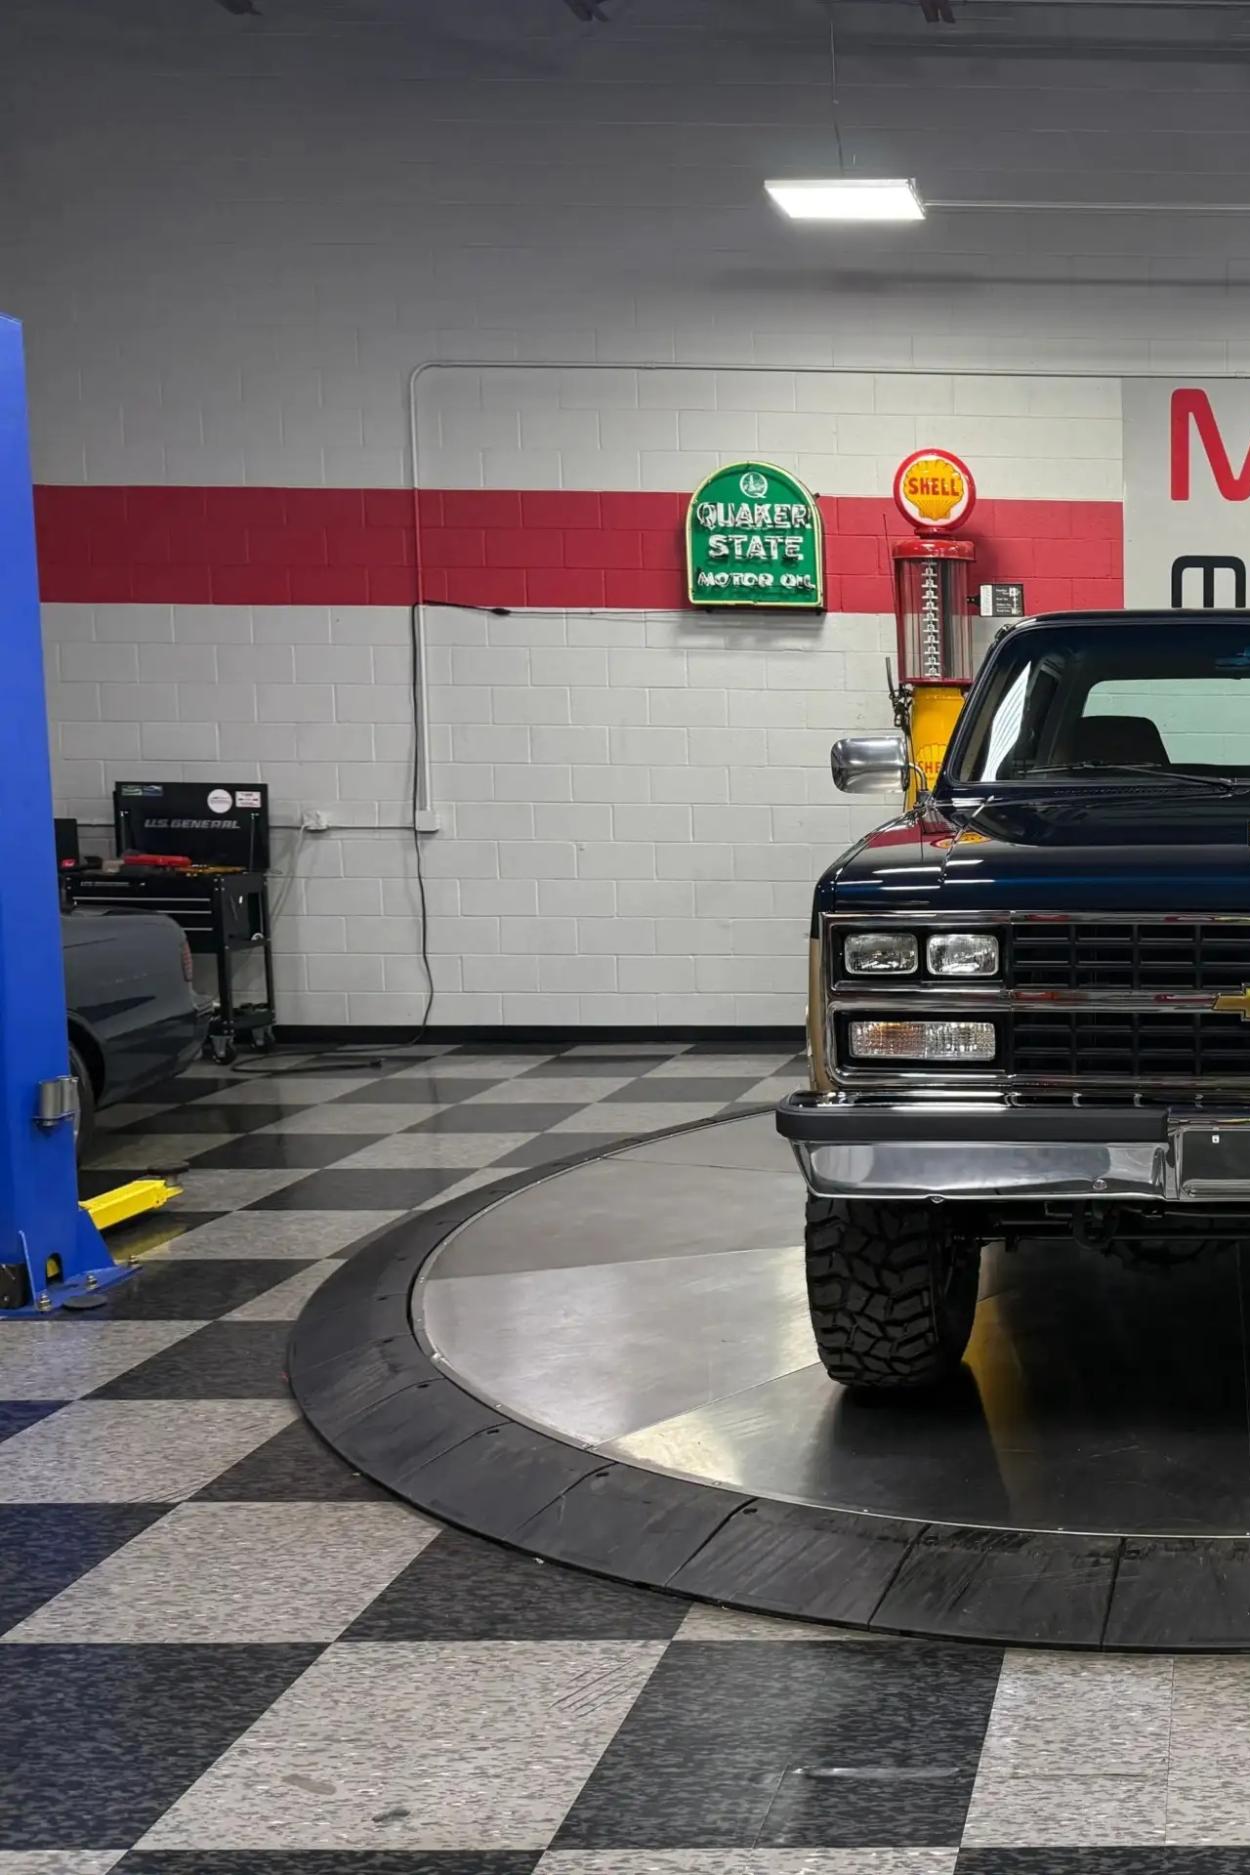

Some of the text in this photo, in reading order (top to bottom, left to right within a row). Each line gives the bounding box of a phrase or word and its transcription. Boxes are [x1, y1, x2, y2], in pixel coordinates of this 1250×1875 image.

[908, 477, 960, 497] SHELL
[696, 502, 812, 530] QUAKER
[708, 534, 804, 561] STATE
[697, 571, 816, 590] MOTOR OIL
[170, 818, 241, 829] GENERAL
